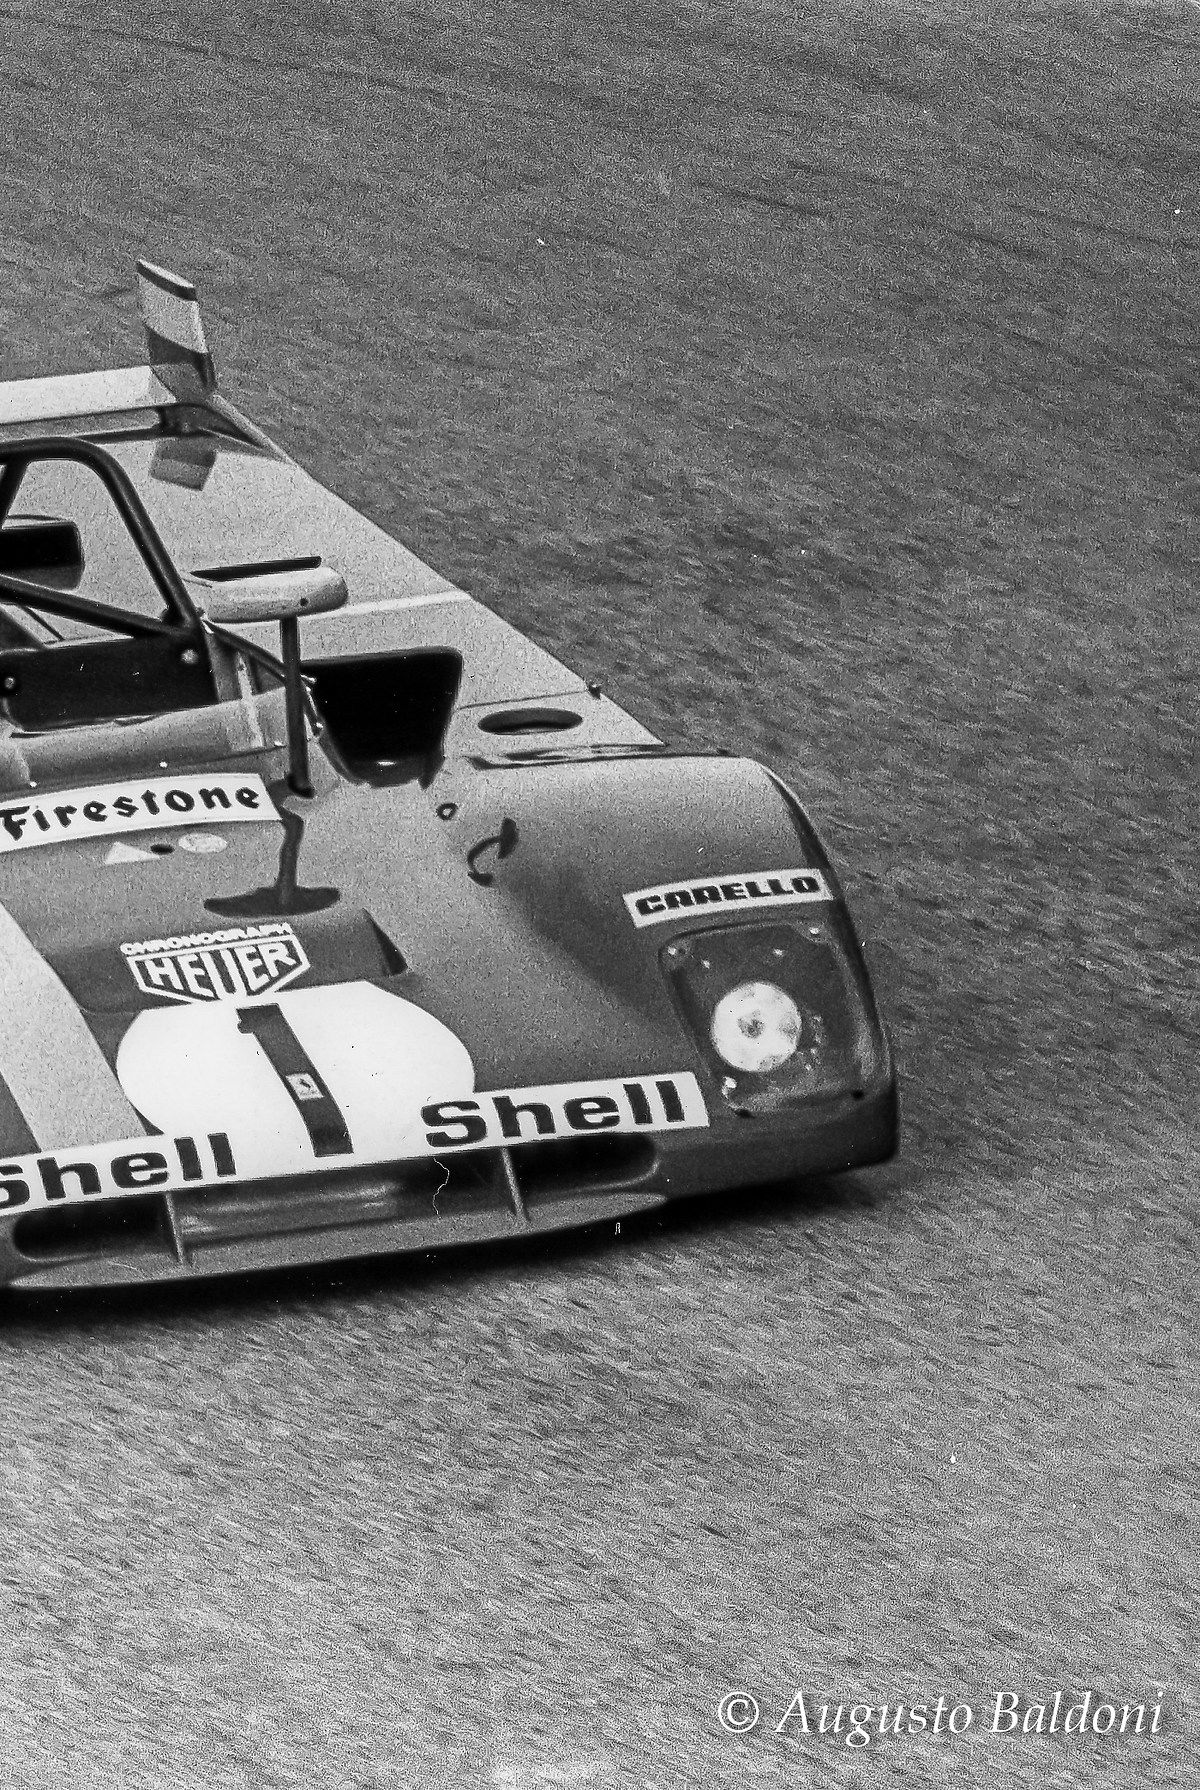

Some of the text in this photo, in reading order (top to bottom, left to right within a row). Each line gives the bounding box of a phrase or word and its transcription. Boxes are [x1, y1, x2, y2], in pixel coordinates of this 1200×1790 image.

[635, 876, 821, 916] CARELLO
[145, 941, 297, 1000] HEUER
[236, 1003, 354, 1158] 1
[420, 1080, 686, 1148] Shell
